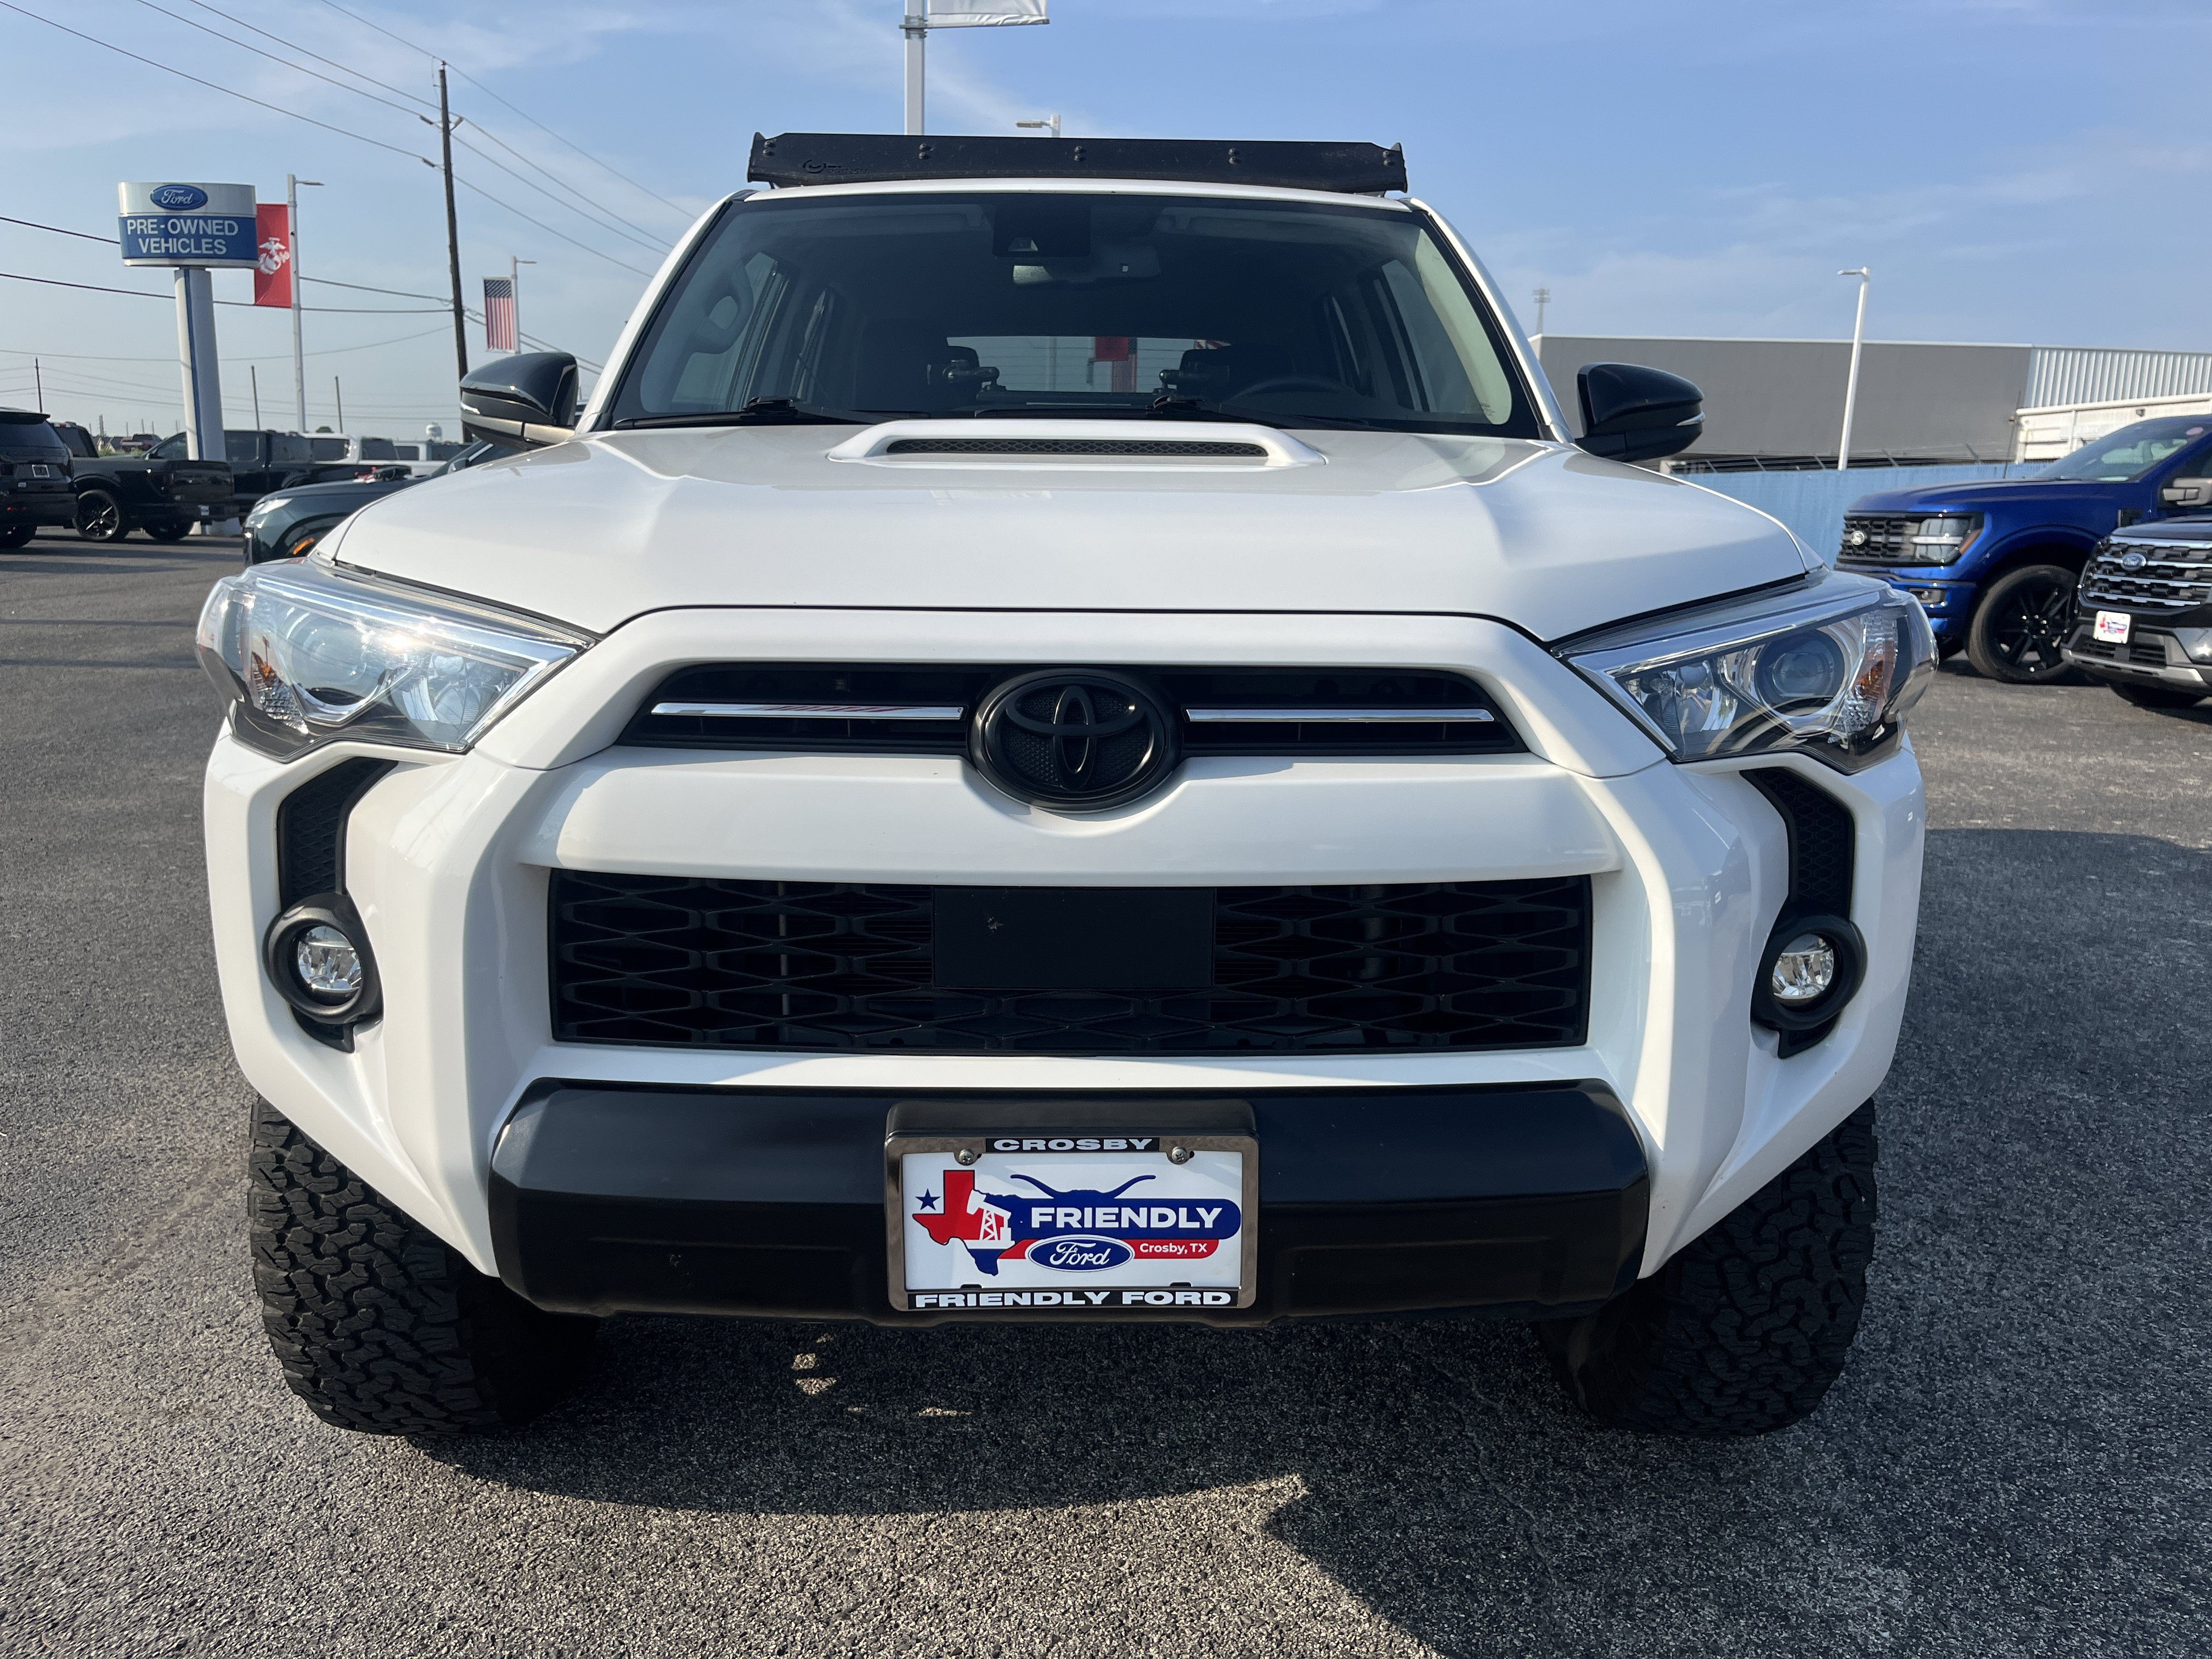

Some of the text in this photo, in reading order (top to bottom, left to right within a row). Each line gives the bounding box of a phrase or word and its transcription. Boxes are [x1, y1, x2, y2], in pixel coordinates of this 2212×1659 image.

[161, 188, 194, 205] Ford
[126, 218, 239, 236] PRE-OWNED
[138, 238, 227, 255] VEHICLES
[993, 1138, 1153, 1152] CROSBY
[1031, 1207, 1223, 1229] FRIENDLY
[1049, 1241, 1111, 1266] Ford
[1139, 1242, 1208, 1255] Crosby, TX
[915, 1291, 1232, 1308] FRIENDLY FORD
